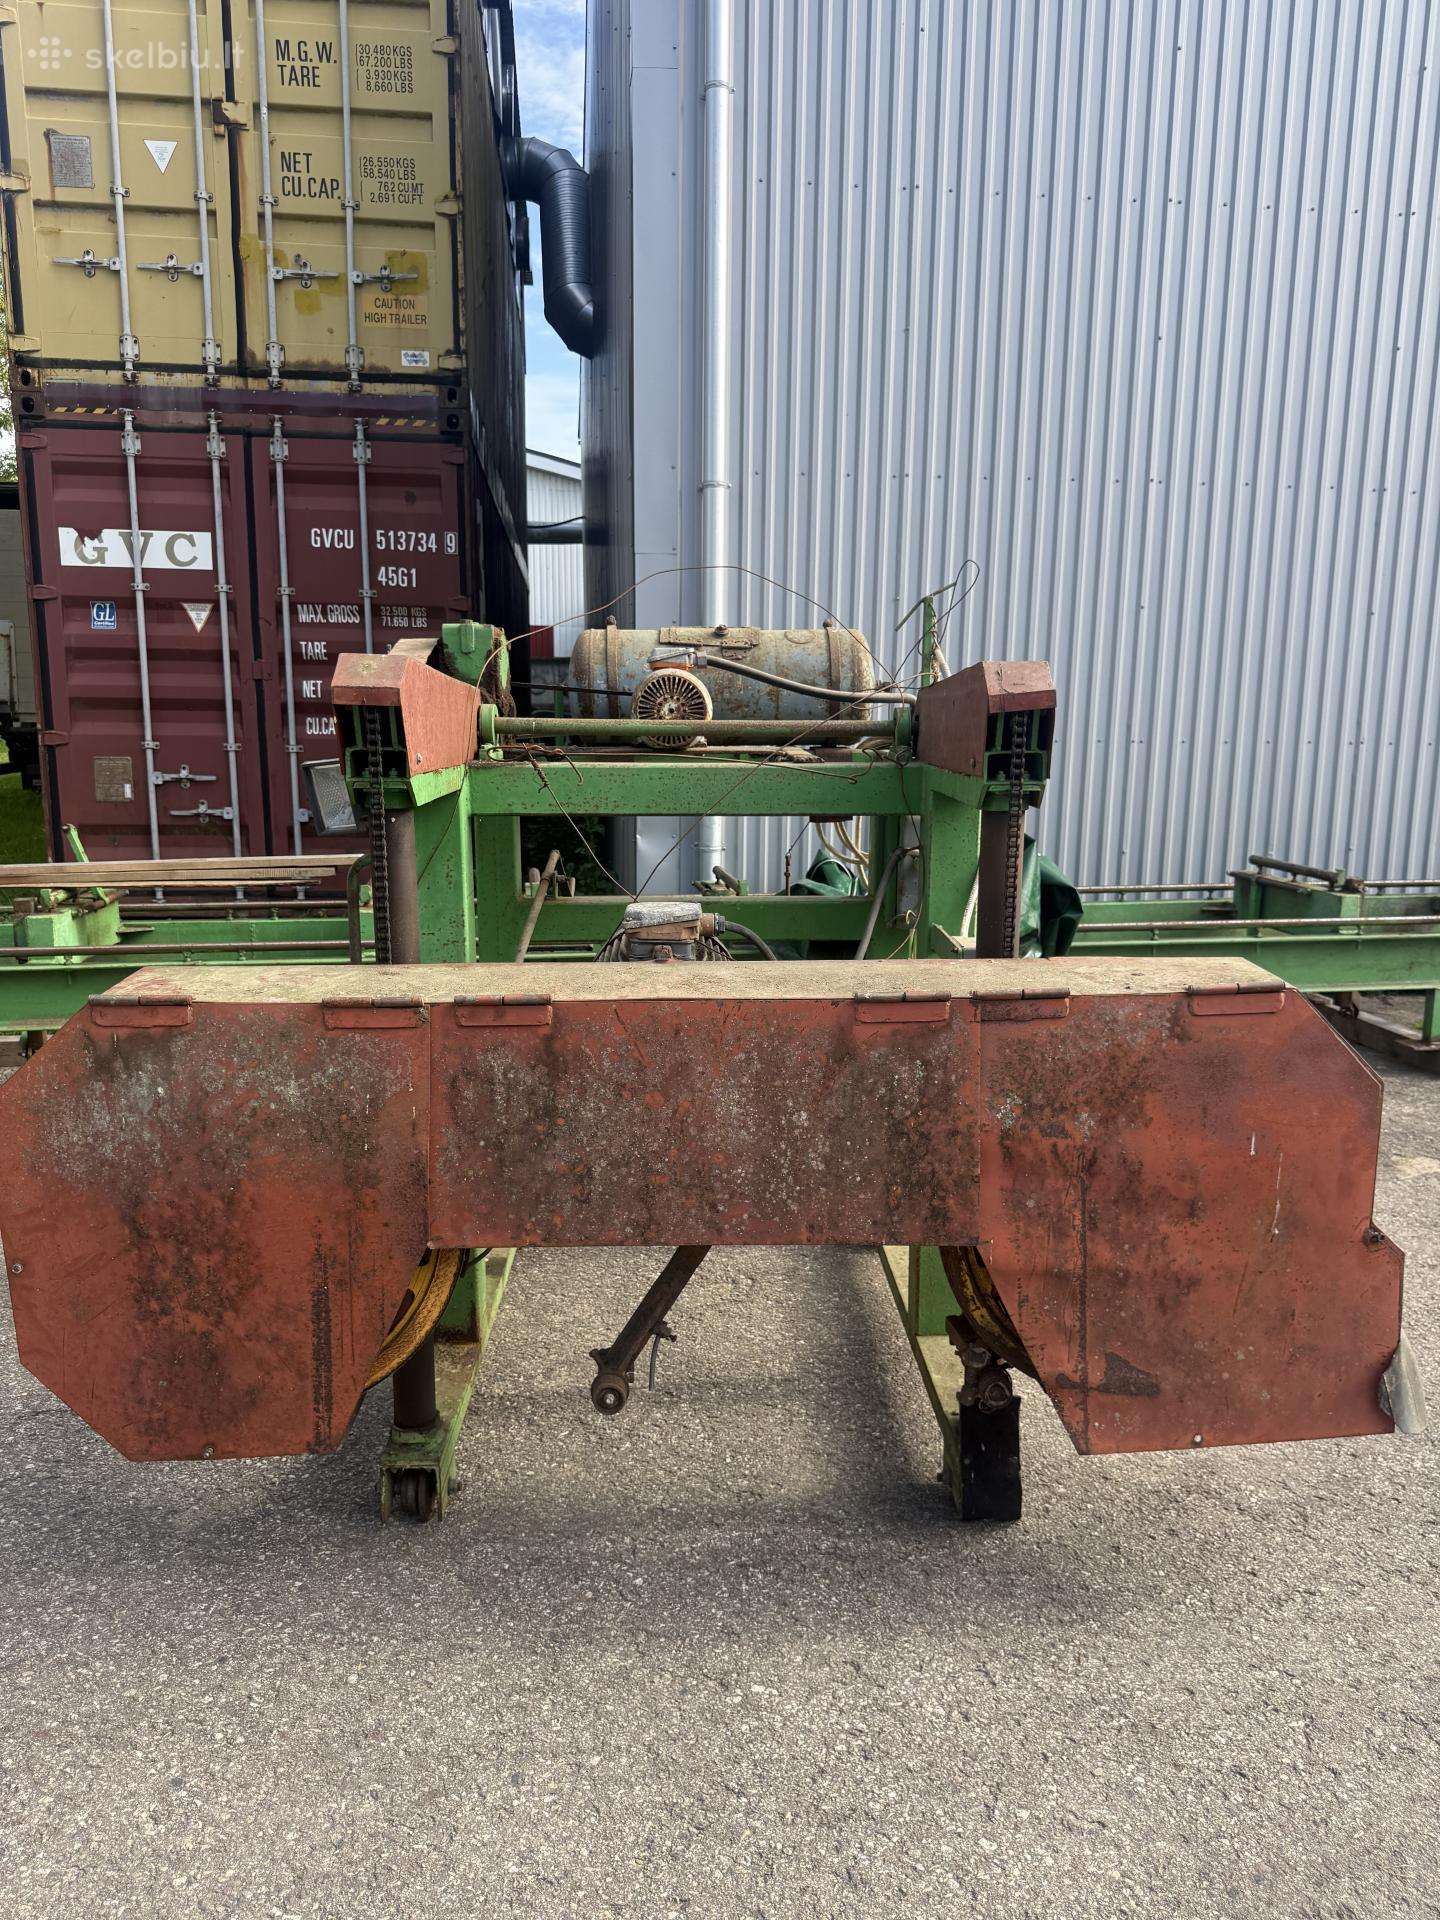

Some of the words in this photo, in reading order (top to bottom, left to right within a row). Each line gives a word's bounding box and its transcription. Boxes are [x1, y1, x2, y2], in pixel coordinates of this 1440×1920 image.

[275, 39, 337, 64] M.G.W.
[393, 45, 413, 57] KGS
[394, 57, 413, 69] LBS
[277, 64, 321, 87] TARE
[393, 70, 413, 82] KGS
[395, 82, 414, 93] LBS
[281, 152, 312, 174] NET
[396, 157, 416, 169] KGS
[397, 169, 416, 181] LBS
[282, 175, 341, 200] CU.CAP.
[374, 297, 415, 310] CAUTION
[364, 312, 387, 324] HIGH
[389, 313, 427, 325] TRAILER
[311, 528, 354, 549] GVCU
[376, 530, 437, 553] 513734
[446, 533, 456, 553] 9
[377, 566, 417, 588] 45G1
[93, 603, 114, 620] GL
[297, 604, 326, 623] MAX.
[327, 605, 360, 624] GROSS
[411, 617, 428, 628] LBS
[299, 641, 328, 660] TARE
[302, 680, 323, 698] NET
[306, 716, 337, 735] CU.CA
